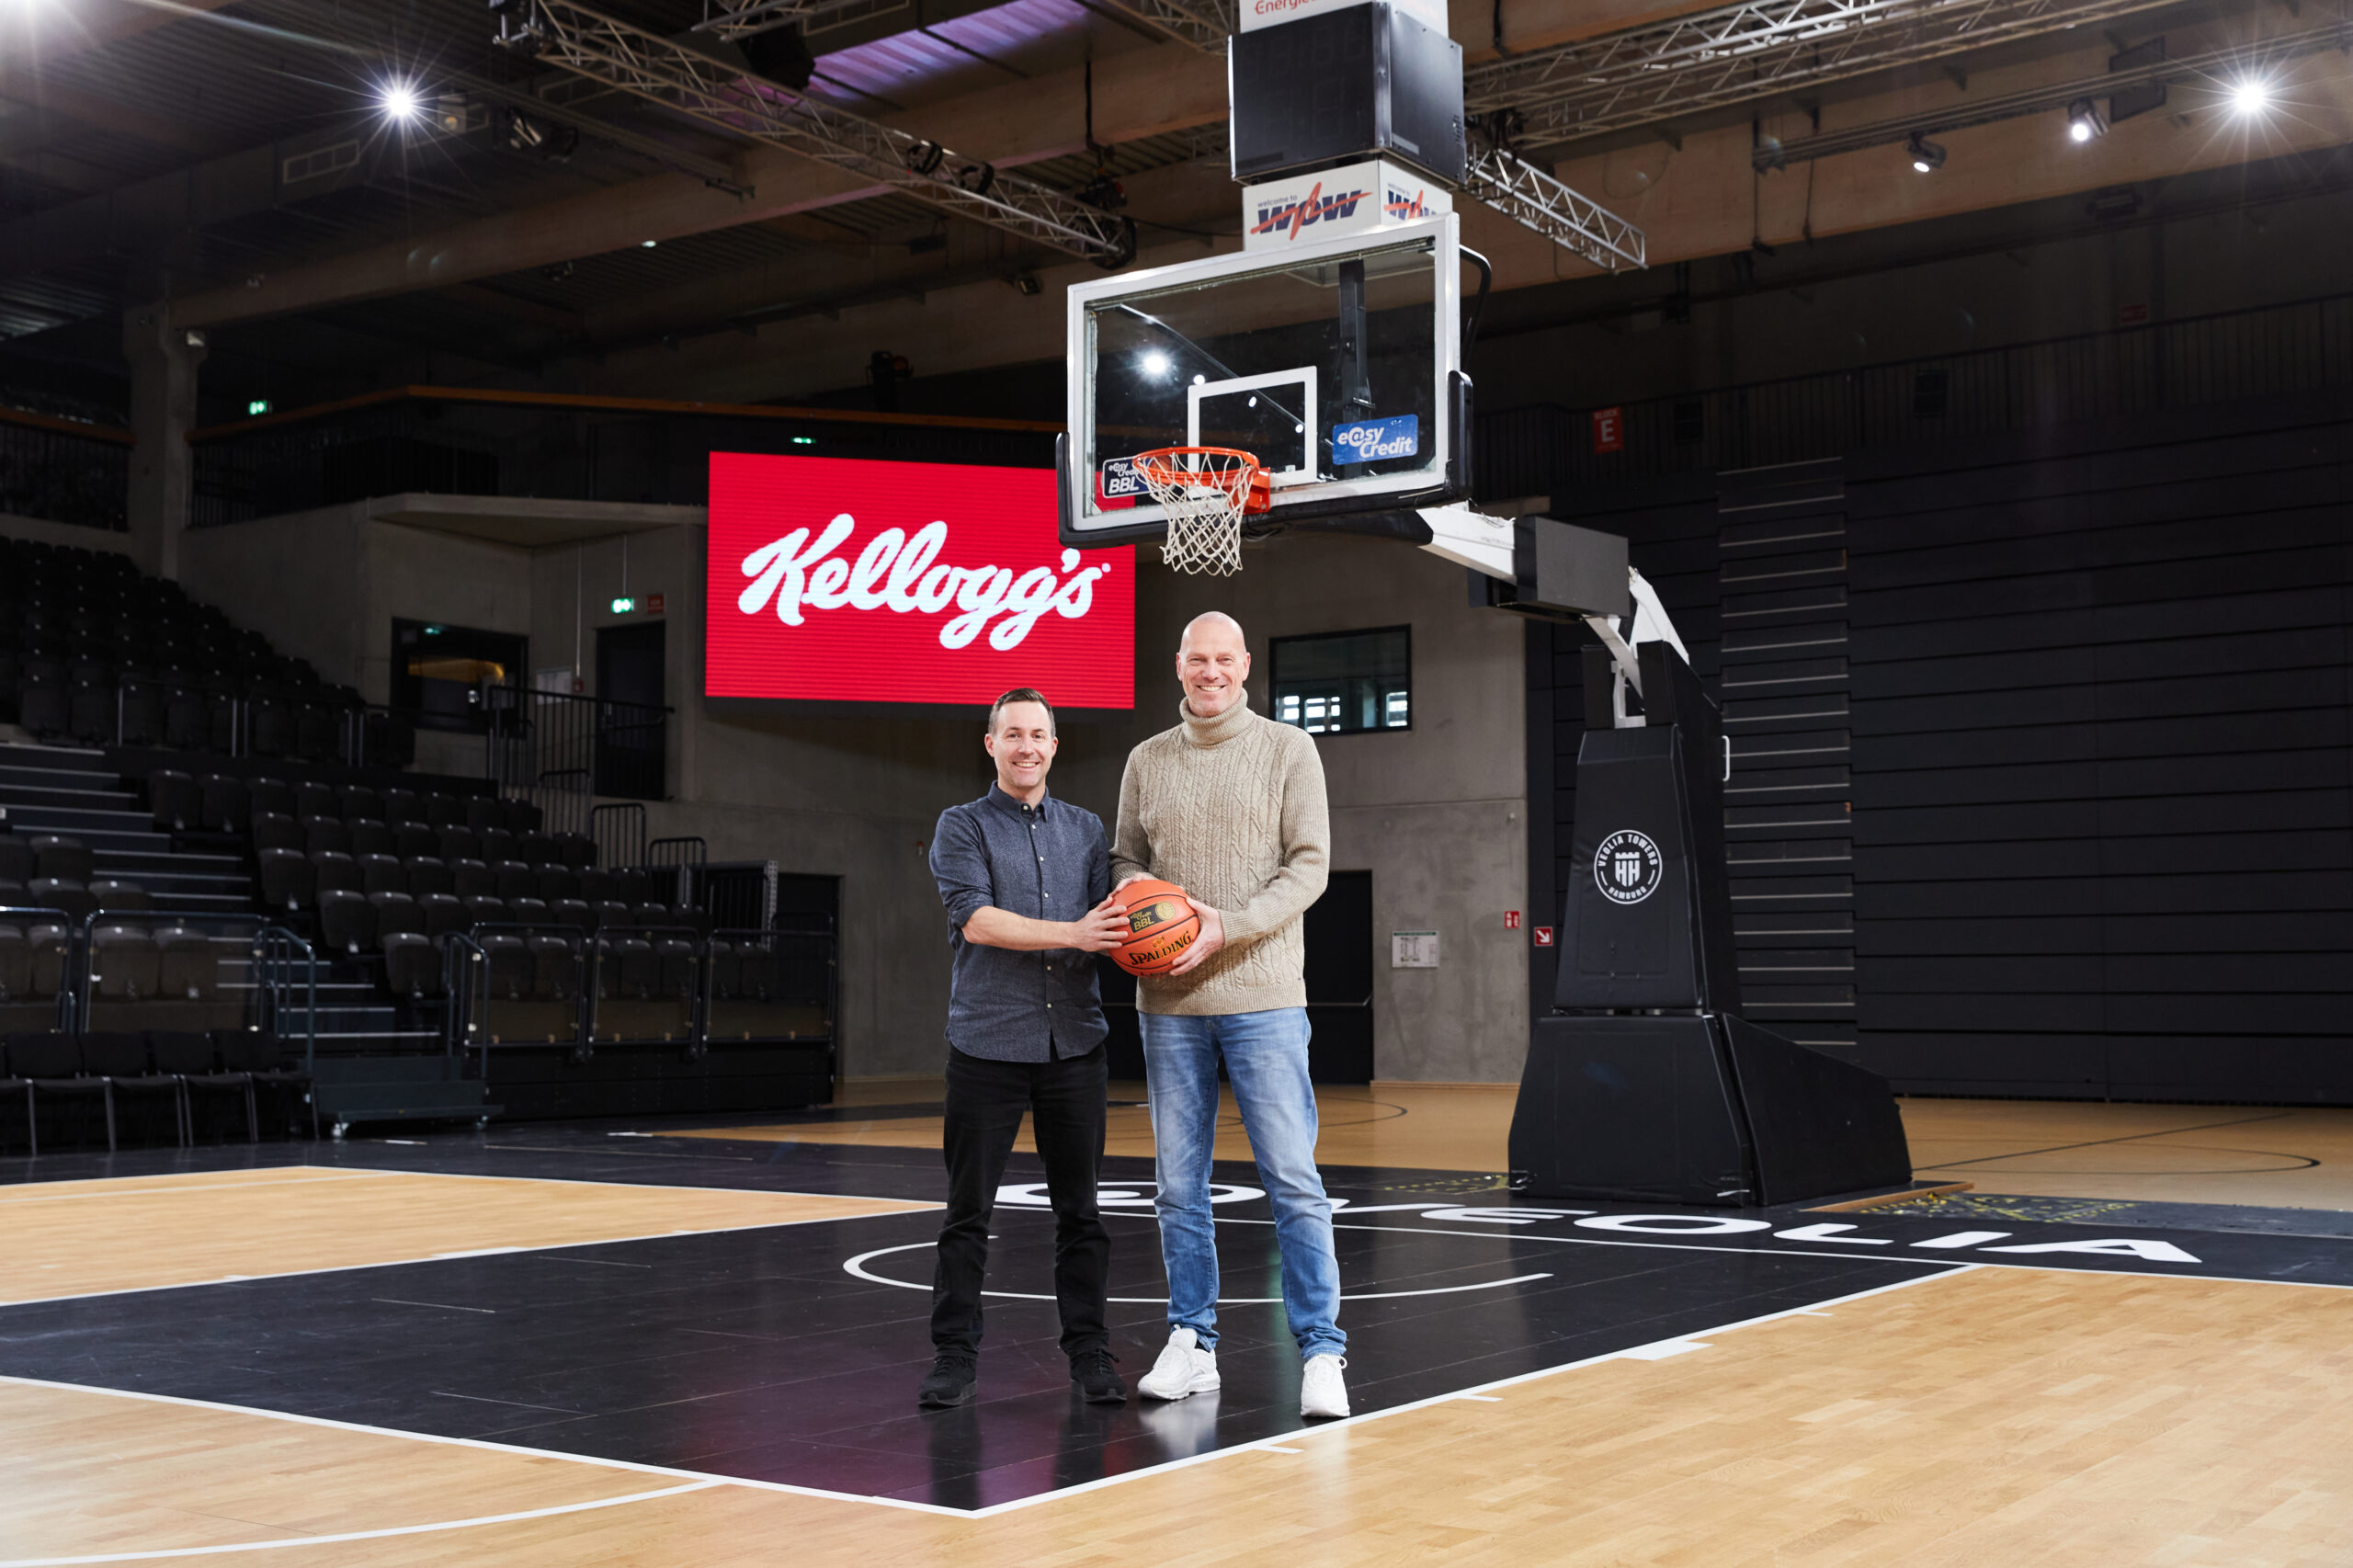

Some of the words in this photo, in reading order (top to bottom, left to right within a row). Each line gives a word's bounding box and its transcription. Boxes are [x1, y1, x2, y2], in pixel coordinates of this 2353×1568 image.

[1257, 195, 1289, 208] welcome
[1290, 186, 1298, 201] to
[1600, 419, 1615, 442] E
[1359, 437, 1412, 459] Credit
[1108, 475, 1140, 494] BBL
[738, 513, 1103, 651] Kellogg's
[1597, 834, 1624, 867] VEOLIA
[1627, 834, 1658, 866] TOWERS
[1133, 916, 1155, 931] BBL
[1128, 930, 1192, 965] SPALDING
